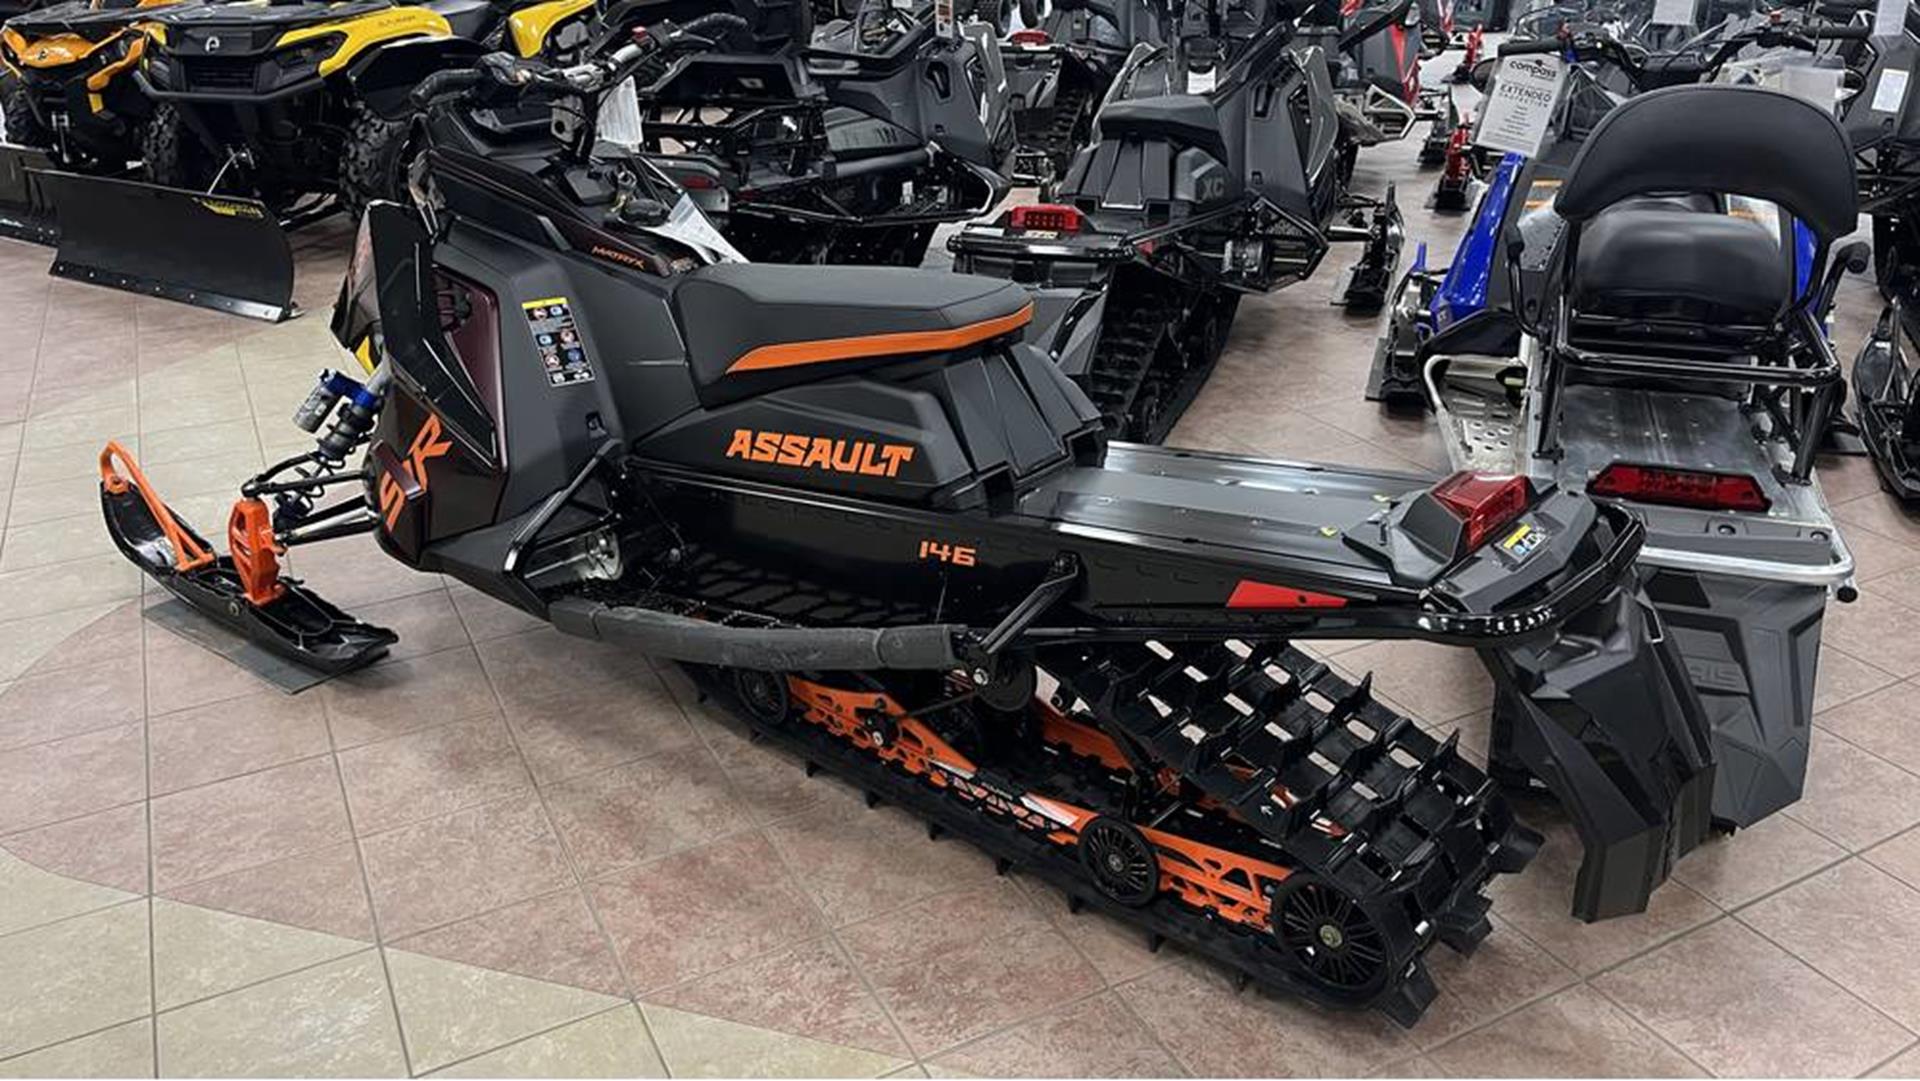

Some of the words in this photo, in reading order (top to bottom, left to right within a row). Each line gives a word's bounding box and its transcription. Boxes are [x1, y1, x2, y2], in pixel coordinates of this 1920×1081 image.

[1500, 83, 1553, 102] EXTENDED
[726, 429, 914, 477] ASSAULT
[918, 540, 976, 567] 146
